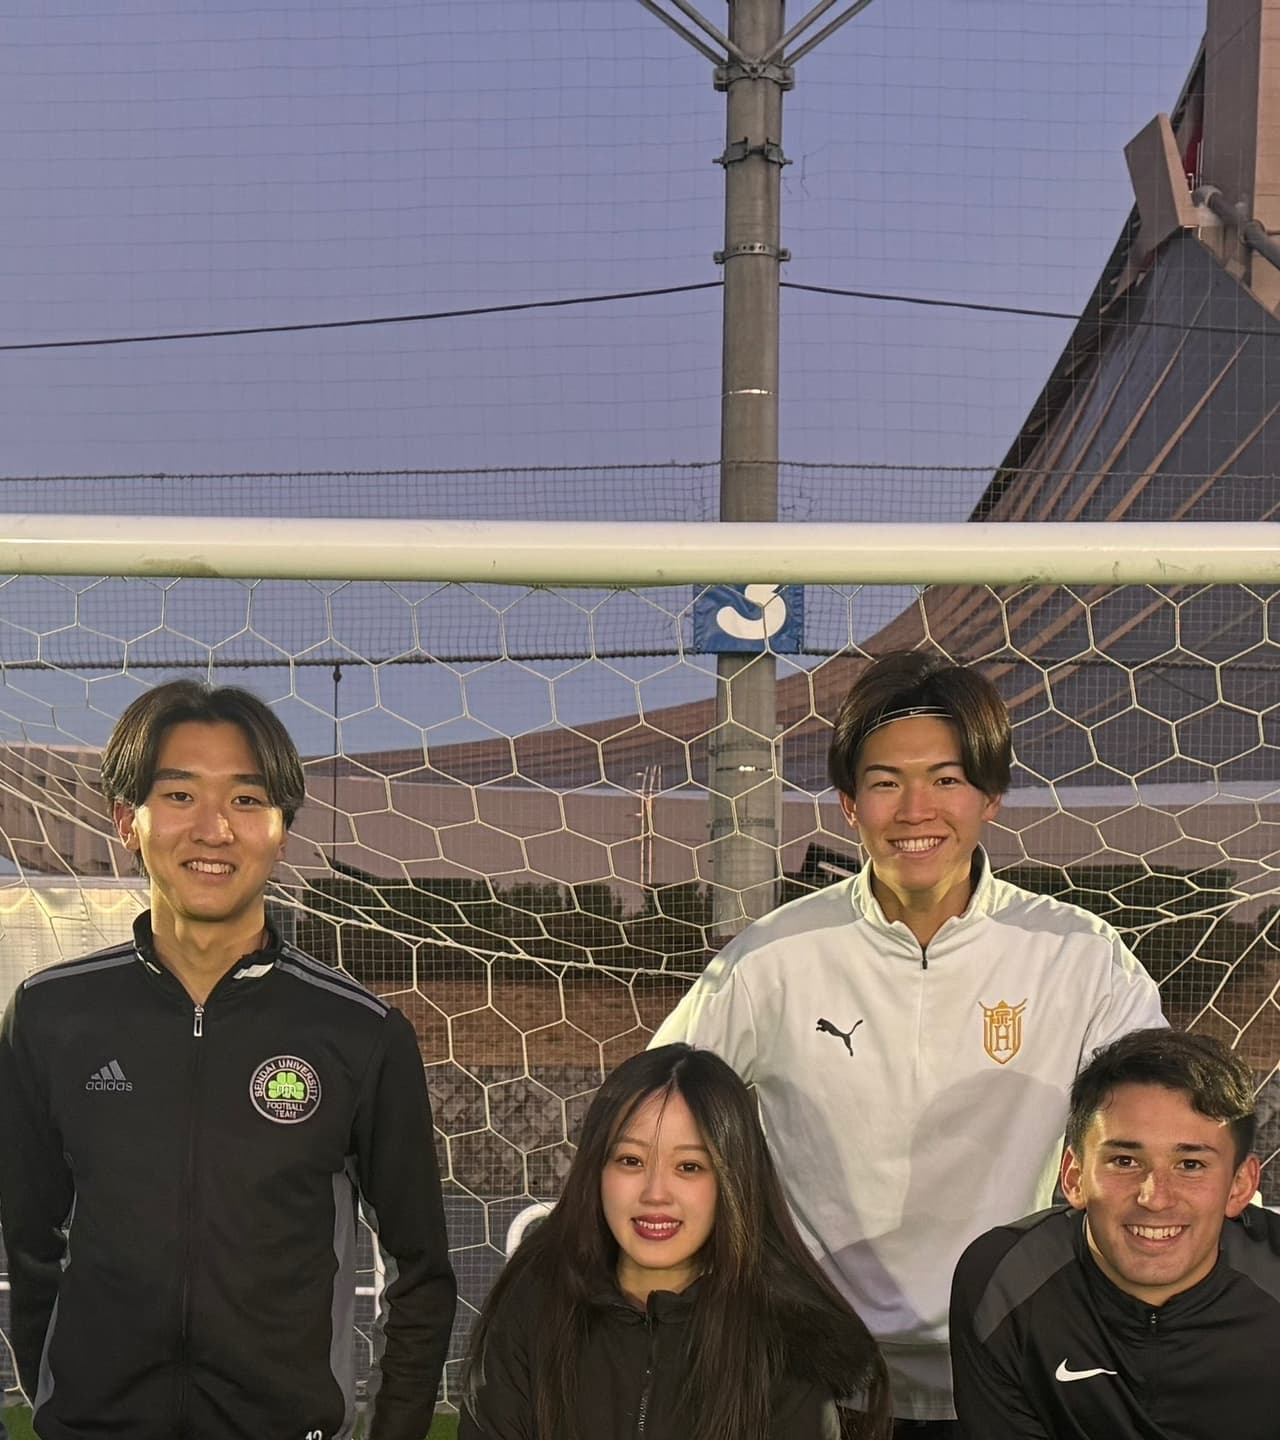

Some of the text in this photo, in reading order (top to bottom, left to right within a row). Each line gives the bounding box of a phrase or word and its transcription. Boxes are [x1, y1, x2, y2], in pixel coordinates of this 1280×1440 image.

[85, 1079, 133, 1092] adidas
[254, 1059, 319, 1102] SENDAI UNIVERSITY
[266, 1101, 305, 1112] FOOTBALL
[275, 1109, 298, 1119] TEAM
